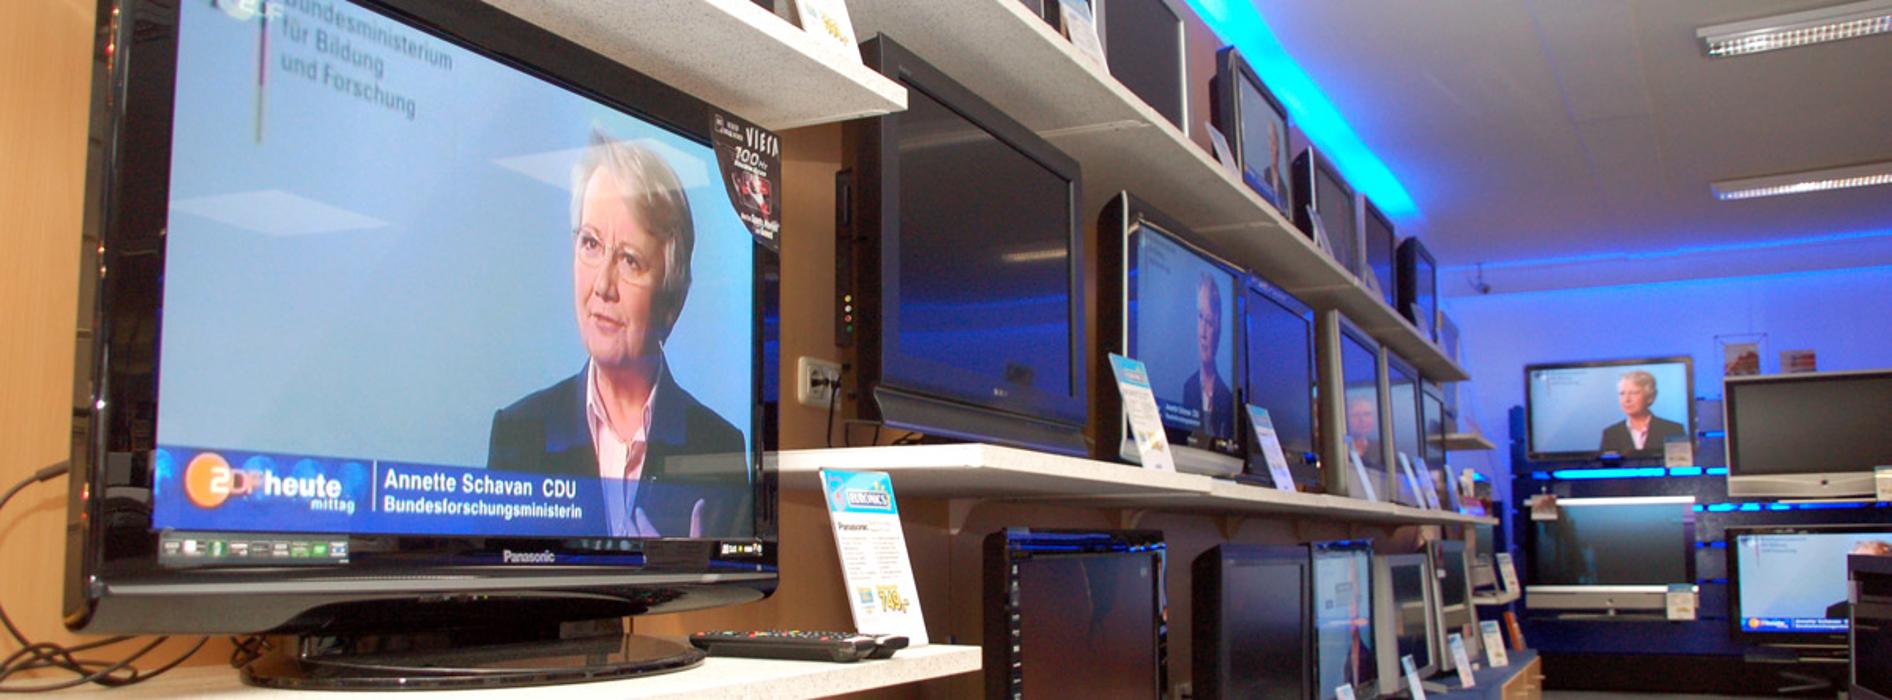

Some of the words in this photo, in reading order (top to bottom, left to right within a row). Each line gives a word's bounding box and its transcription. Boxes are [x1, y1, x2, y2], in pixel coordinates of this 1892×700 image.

[282, 17, 308, 45] für
[315, 30, 384, 79] Bildung
[280, 53, 317, 80] und
[323, 62, 416, 121] Forschung
[735, 146, 760, 167] 100
[264, 469, 342, 498] heute
[384, 468, 457, 493] Annette
[462, 473, 533, 496] Schavan
[542, 479, 577, 499] CDU
[310, 499, 355, 516] mittag
[383, 495, 583, 521] Bundesforschungsministerin
[503, 550, 556, 563] Panasonic
